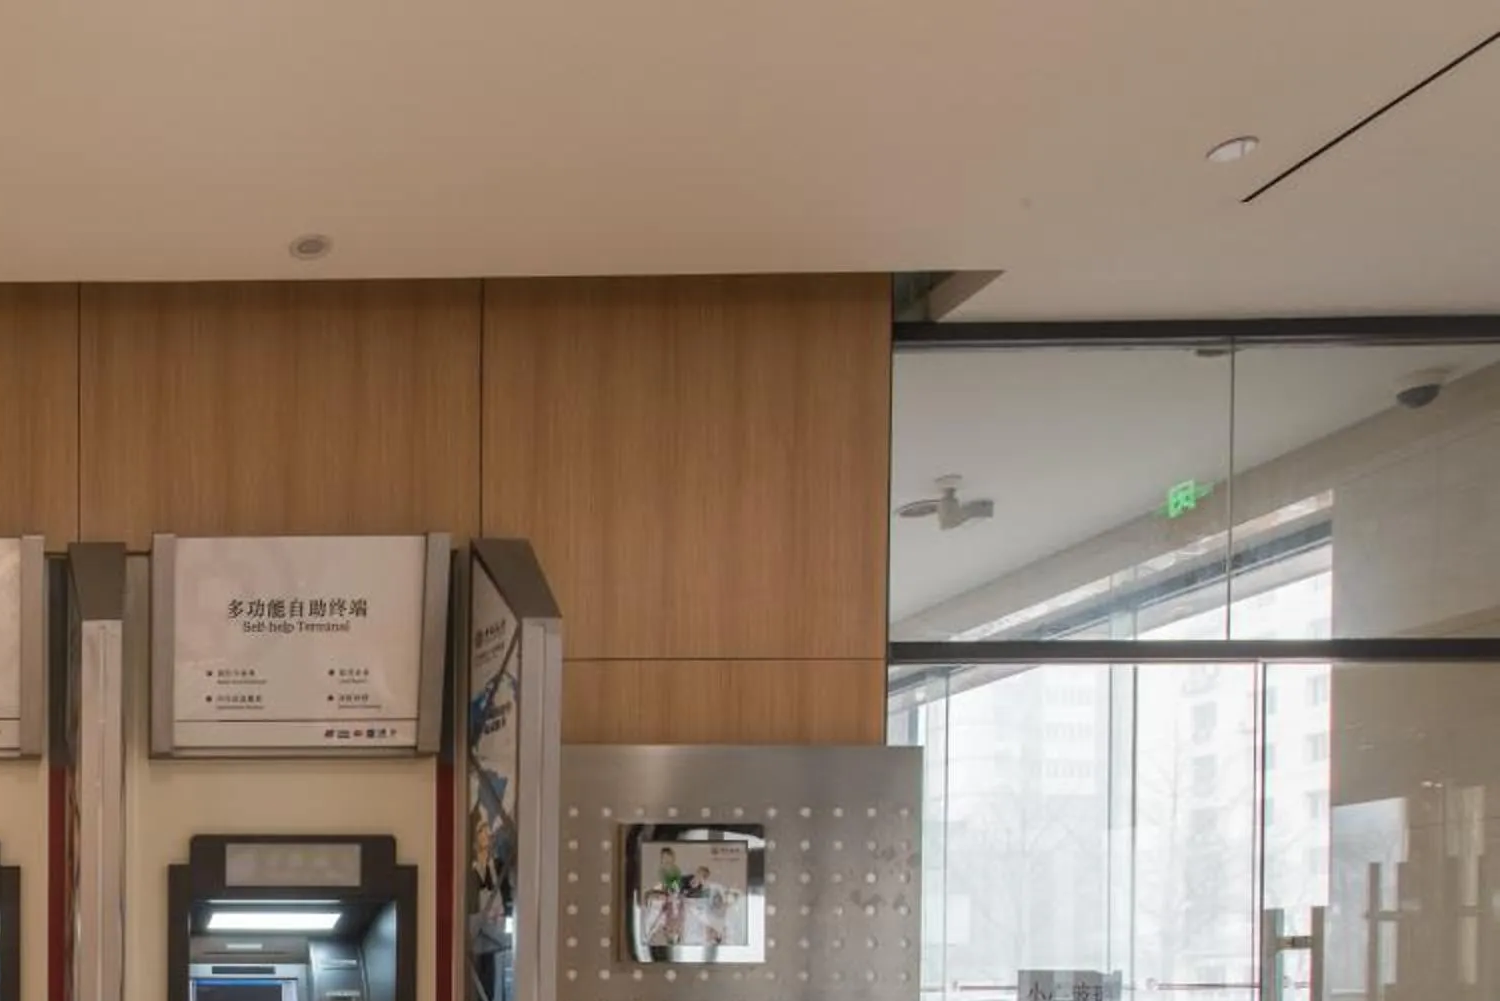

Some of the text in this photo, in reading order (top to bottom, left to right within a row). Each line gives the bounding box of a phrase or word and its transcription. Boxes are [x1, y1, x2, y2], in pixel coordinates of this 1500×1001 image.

[228, 598, 367, 618] 多功能自助终端
